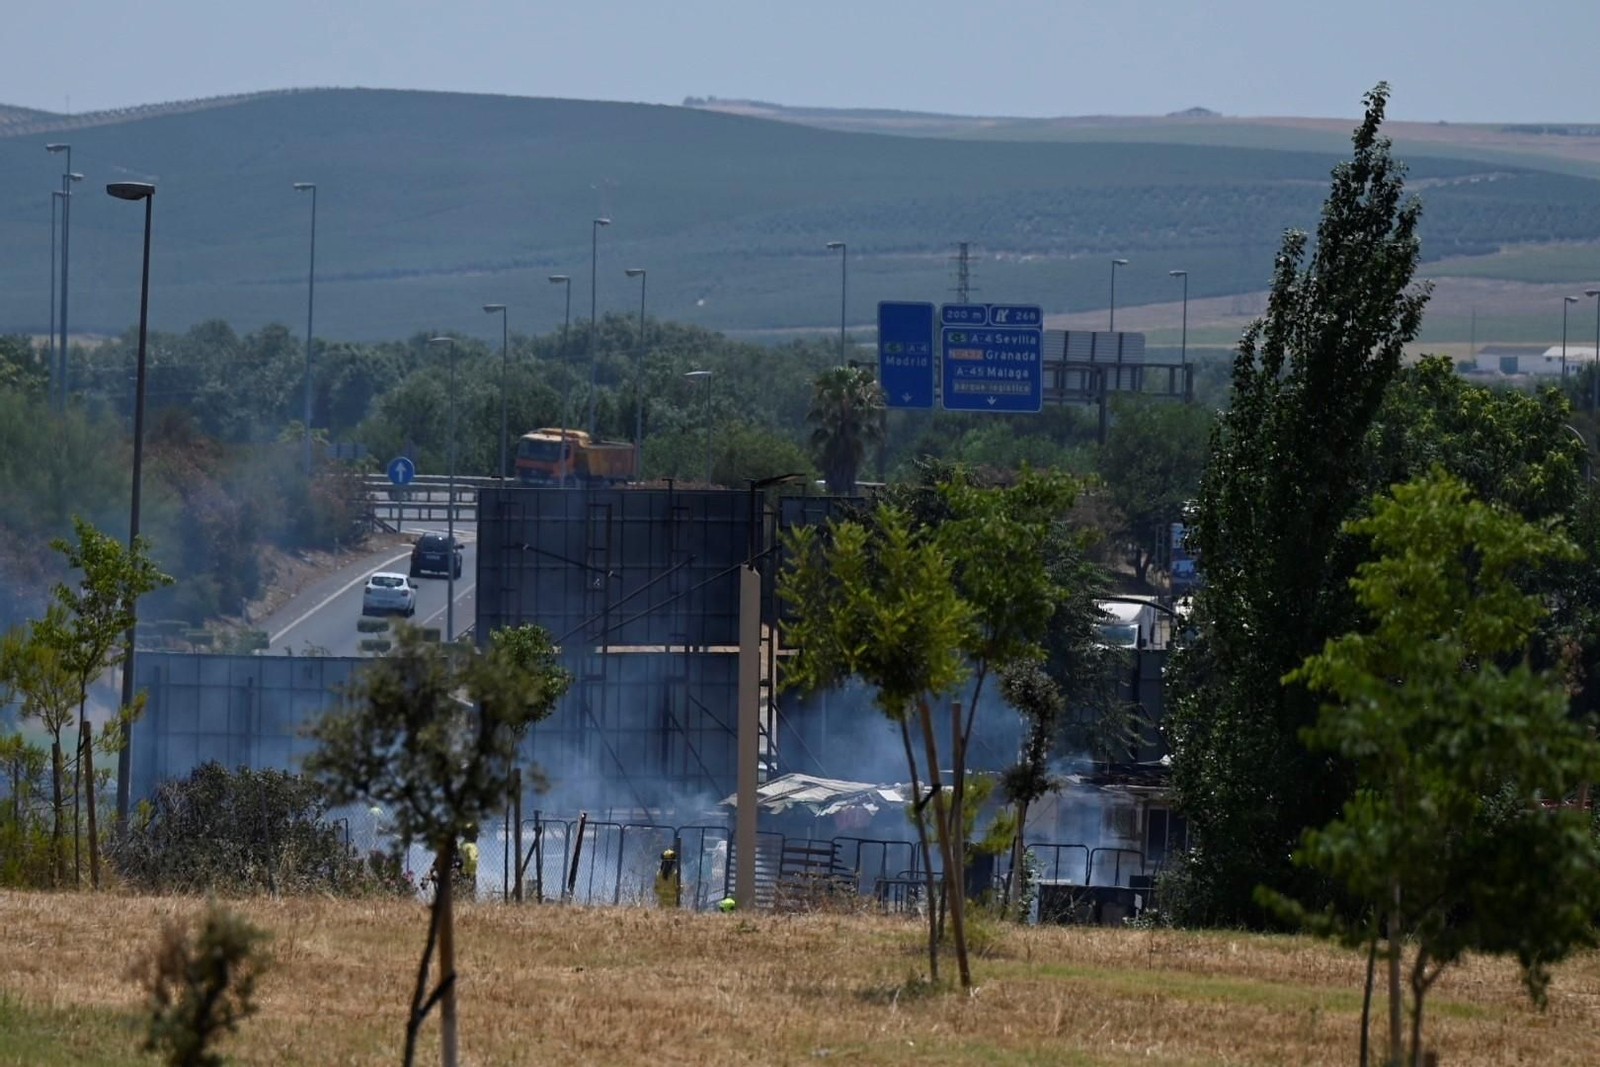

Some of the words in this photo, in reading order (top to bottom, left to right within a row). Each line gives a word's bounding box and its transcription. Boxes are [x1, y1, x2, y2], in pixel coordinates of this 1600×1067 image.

[947, 310, 968, 319] 200
[971, 333, 992, 343] A-4
[995, 333, 1036, 345] Sevilla
[885, 355, 927, 366] Madrid
[986, 349, 1036, 361] Granada
